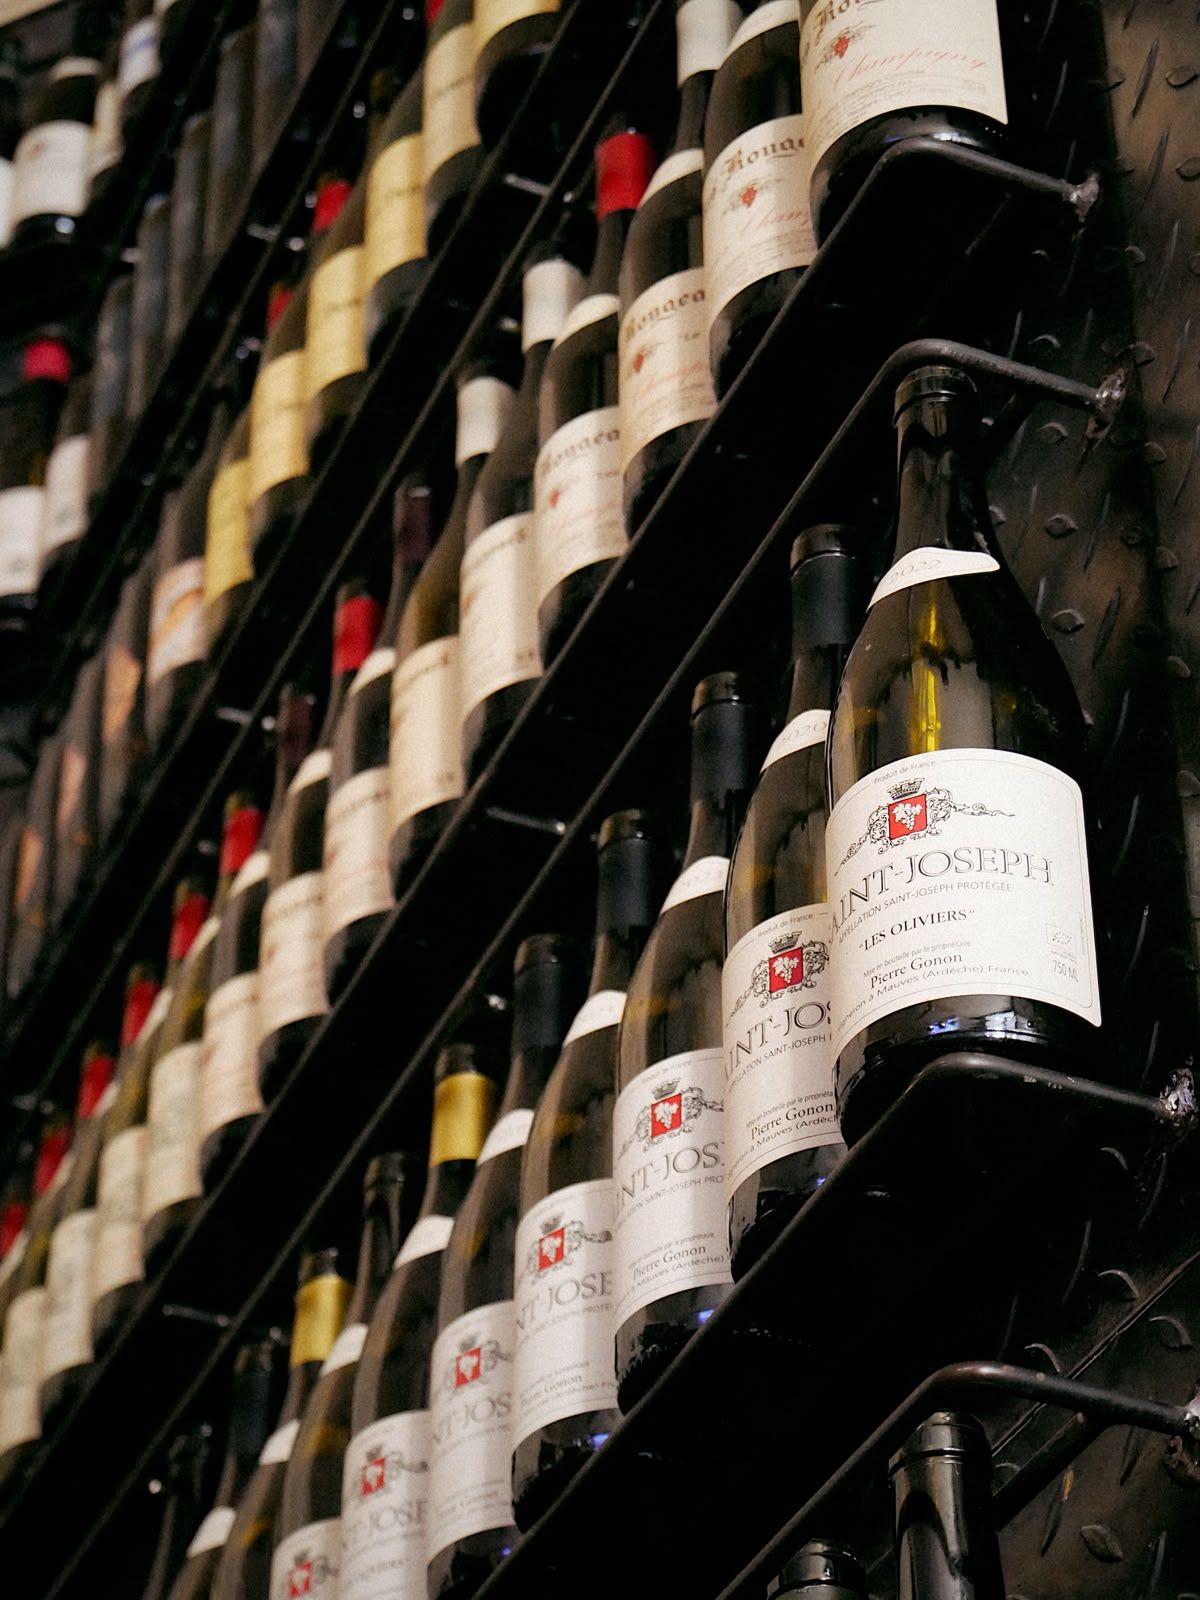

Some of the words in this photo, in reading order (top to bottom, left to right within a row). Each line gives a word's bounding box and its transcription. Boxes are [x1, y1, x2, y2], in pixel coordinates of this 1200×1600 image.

[873, 769, 898, 785] Produit
[900, 766, 909, 774] de
[910, 760, 937, 770] France
[829, 847, 1055, 944] AINT-JOSEPH
[883, 881, 954, 910] SAINT-JOSEPH
[957, 880, 1014, 893] PROTÉGÉE
[863, 966, 876, 979] Mise
[876, 961, 884, 971] en
[884, 952, 910, 968] bouteille
[911, 948, 923, 958] par
[924, 944, 931, 953] le
[931, 939, 972, 953] propriétaire
[870, 965, 907, 989] Pierre
[910, 953, 963, 971] Gonon
[1052, 959, 1067, 977] 750
[876, 976, 919, 997] Mauves
[922, 964, 984, 980] (Ardèche)
[987, 965, 1029, 977] France
[764, 1033, 826, 1062] SAINT-JOSEPH
[750, 1116, 782, 1140] Pierre
[785, 1103, 834, 1122] Gonon
[756, 1126, 793, 1147] Mauves
[662, 1245, 707, 1265] Gonon
